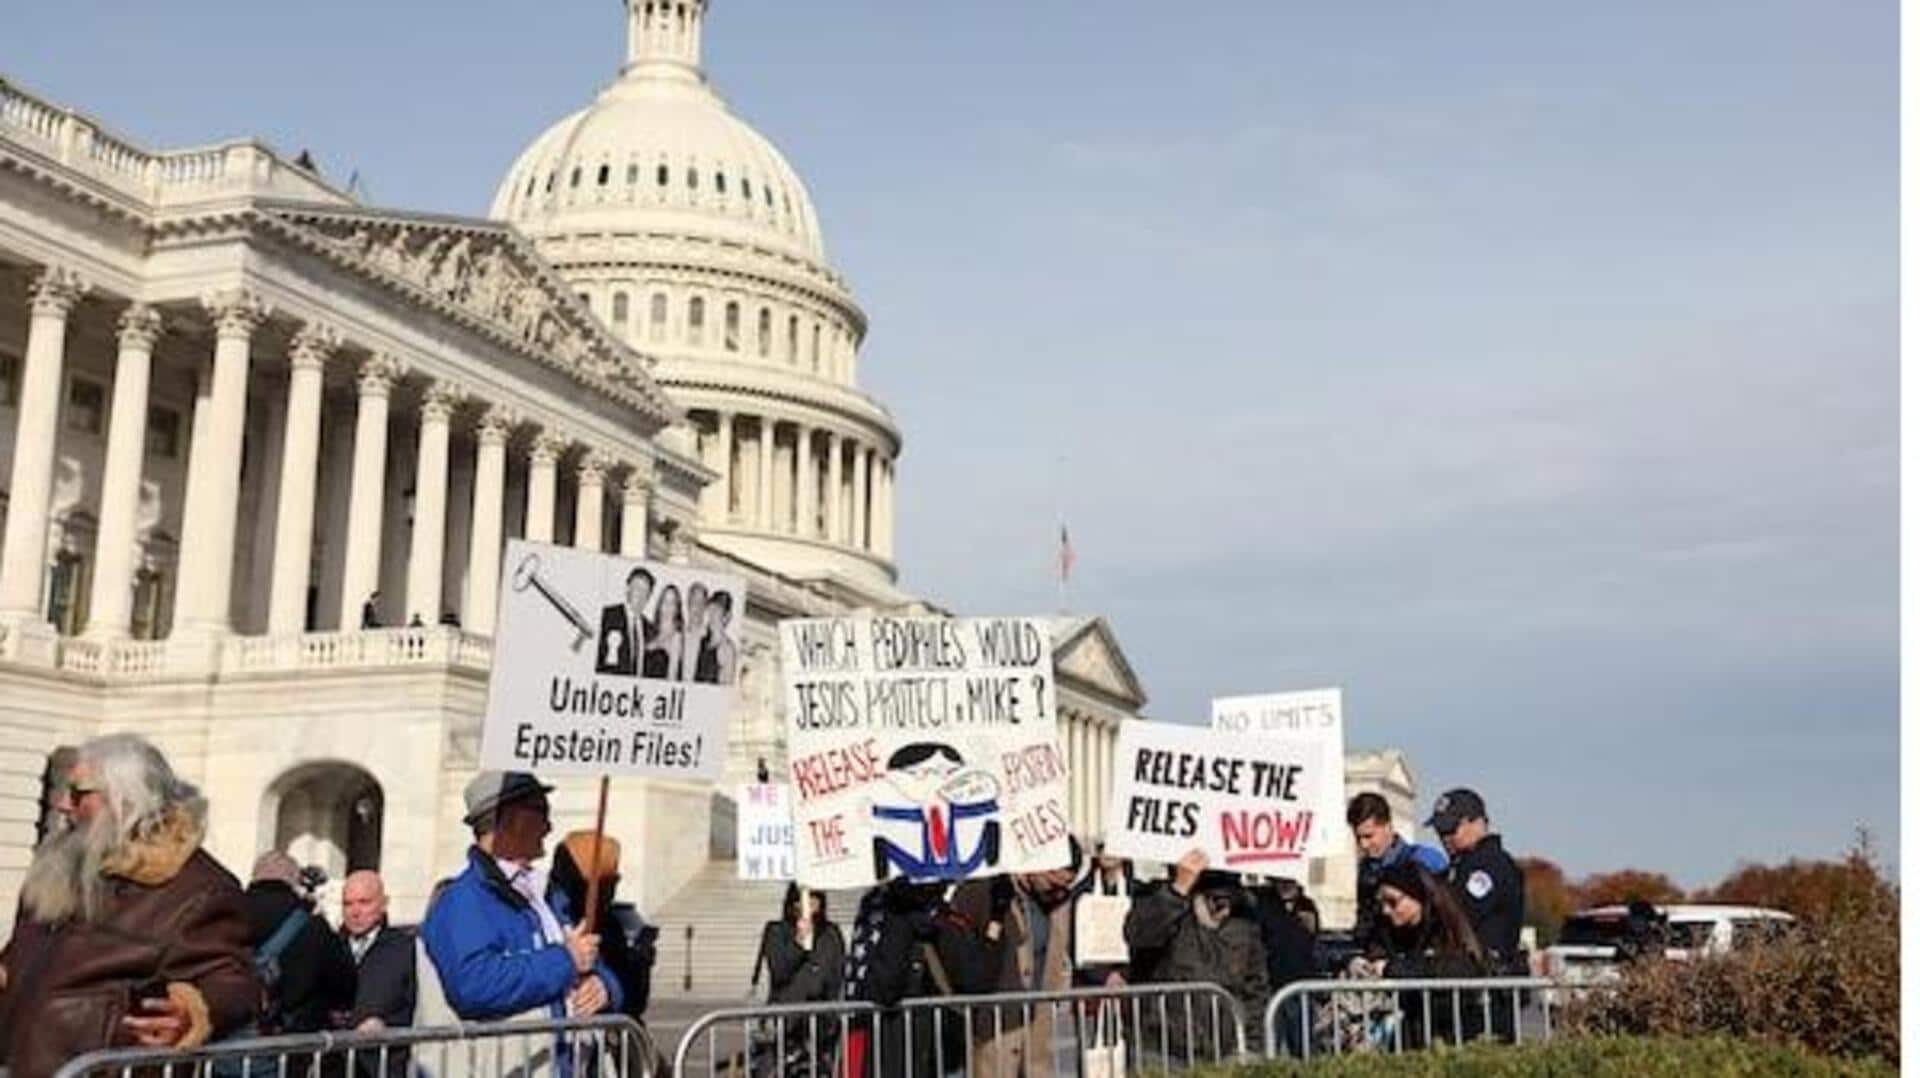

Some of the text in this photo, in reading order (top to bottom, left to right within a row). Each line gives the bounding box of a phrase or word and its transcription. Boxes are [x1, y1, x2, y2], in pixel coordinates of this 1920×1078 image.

[793, 618, 858, 669] WHICH
[549, 676, 686, 721] Unlock all
[794, 680, 858, 730] JESUS
[1218, 703, 1335, 732] NO LIMITS
[514, 723, 702, 768] Epstein Files!
[793, 738, 884, 799] RELEASE
[1135, 747, 1303, 801] RELEASE THE
[808, 814, 848, 857] THE
[1010, 798, 1066, 850] FILES
[1126, 796, 1313, 851] FILES NOW!
